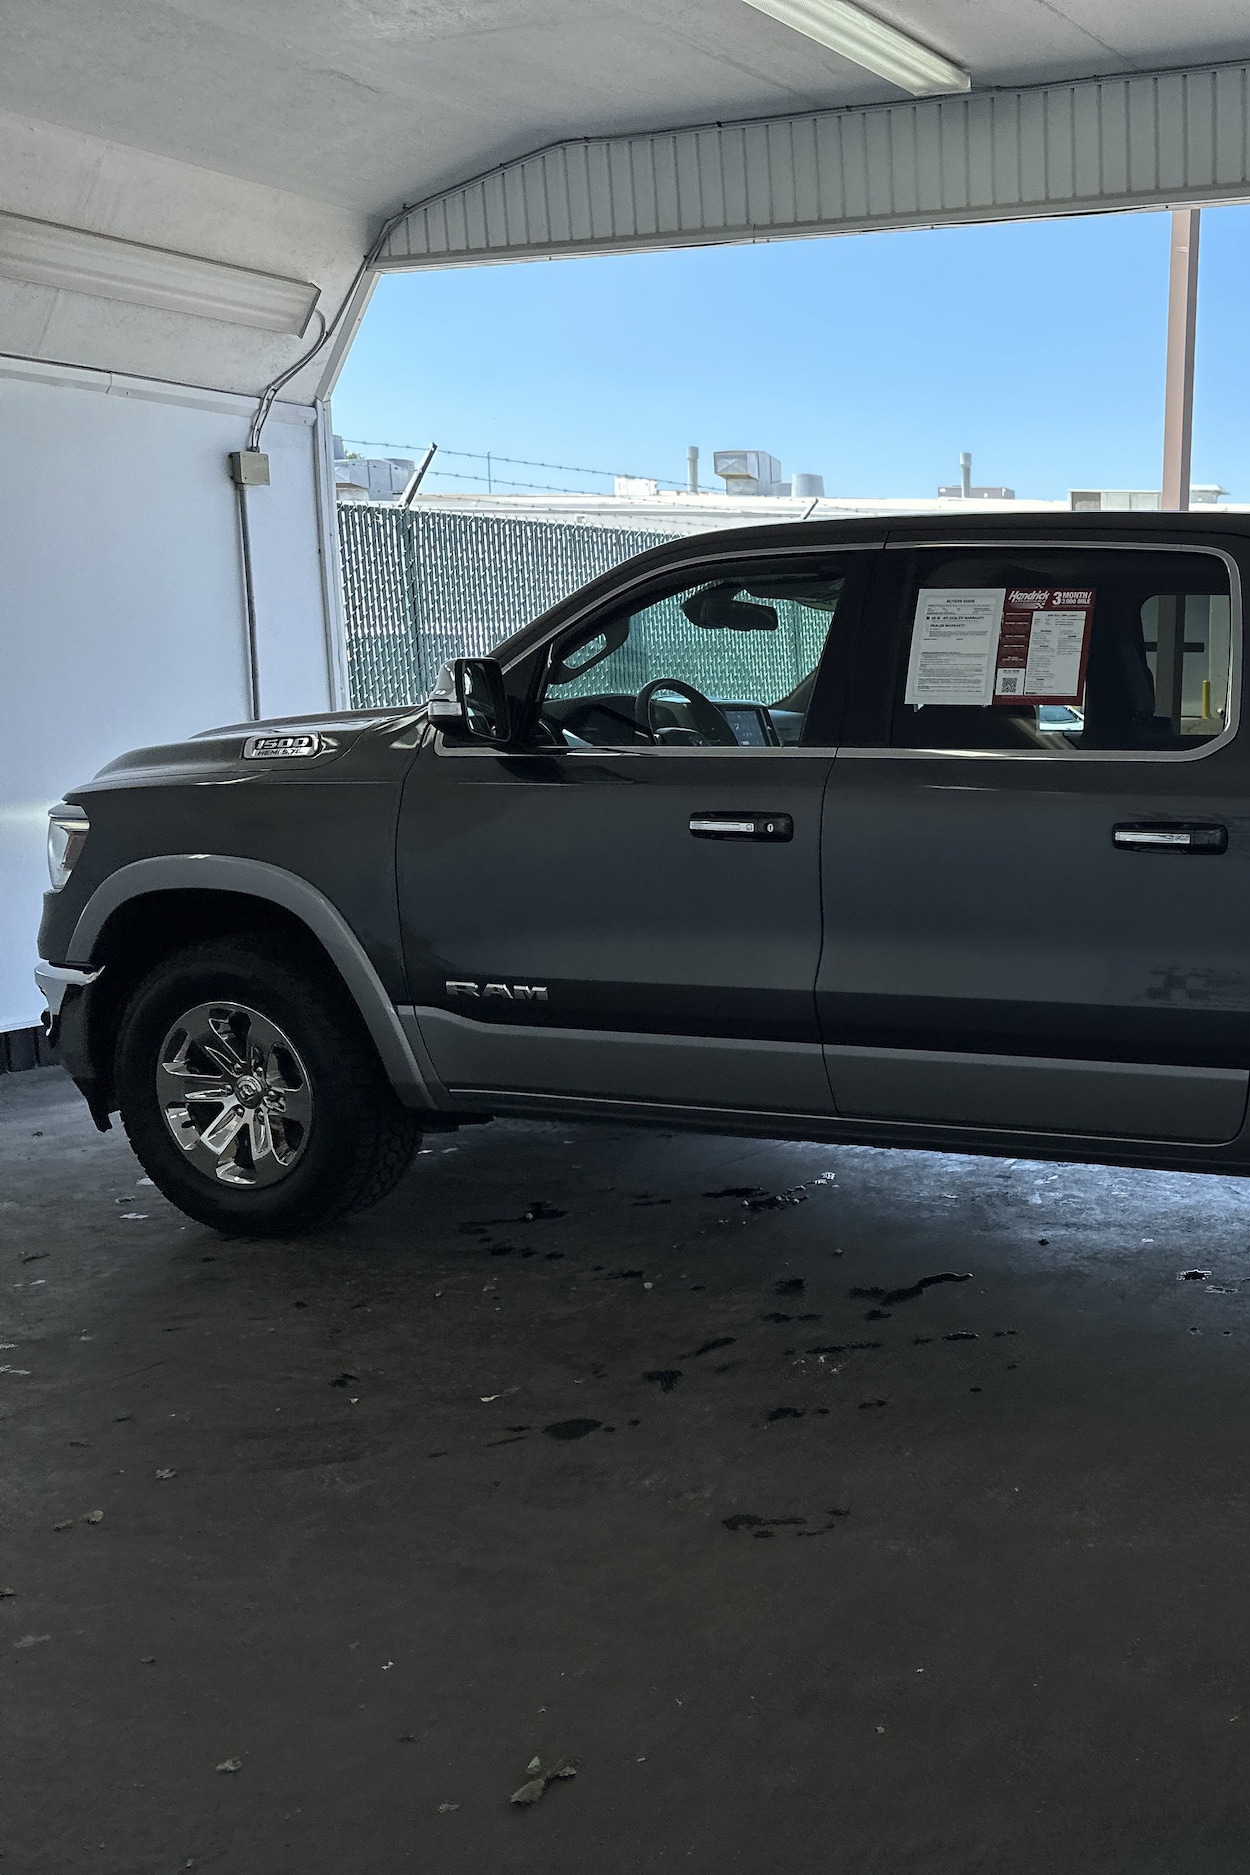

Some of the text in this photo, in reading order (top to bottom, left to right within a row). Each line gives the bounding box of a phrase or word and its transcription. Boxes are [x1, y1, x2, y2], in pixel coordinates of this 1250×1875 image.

[1008, 590, 1050, 603] Hendrick
[1052, 591, 1063, 605] 3
[256, 737, 310, 750] 1500
[445, 980, 549, 1001] RAM
